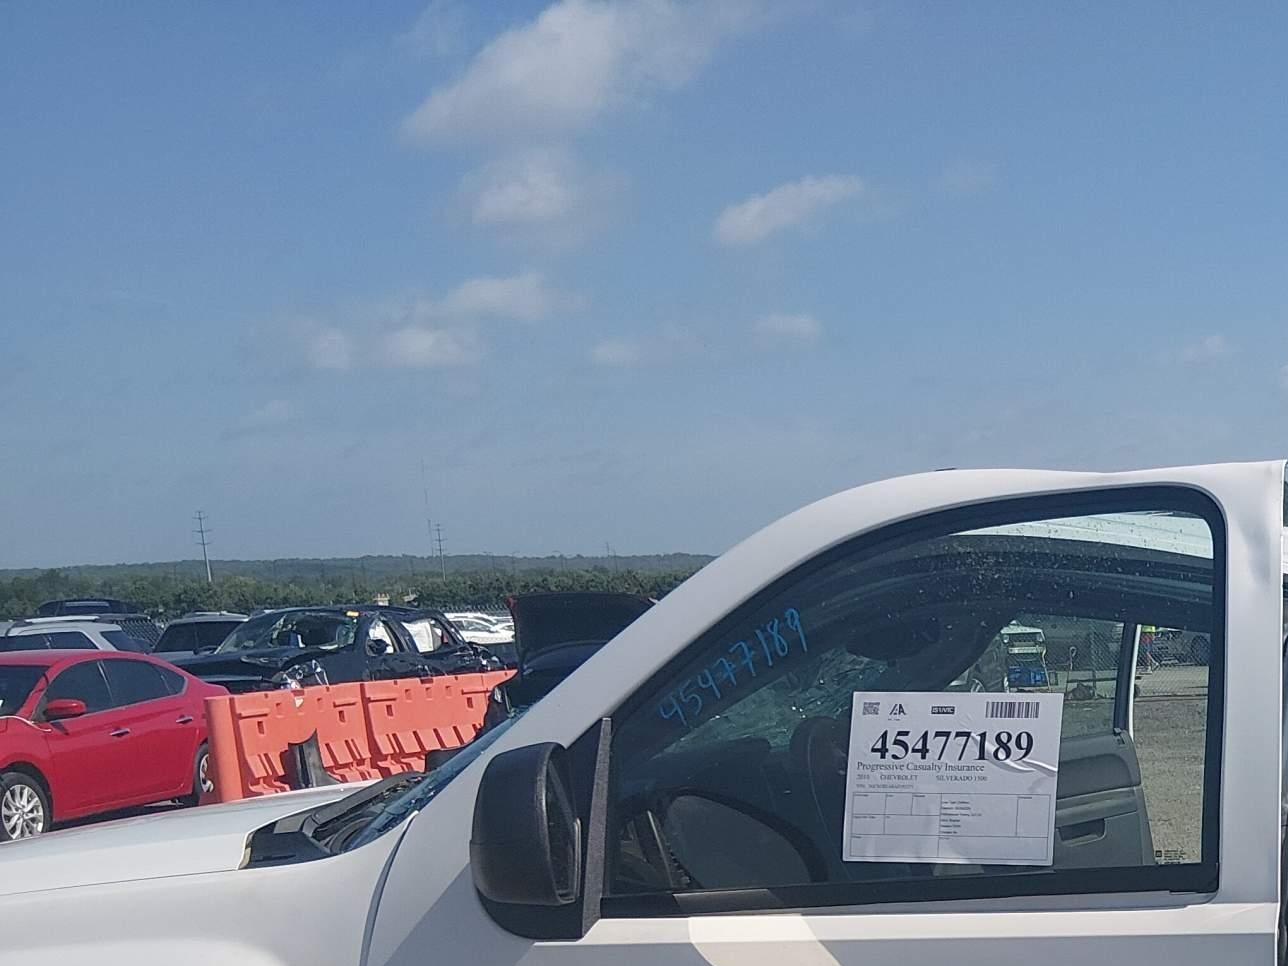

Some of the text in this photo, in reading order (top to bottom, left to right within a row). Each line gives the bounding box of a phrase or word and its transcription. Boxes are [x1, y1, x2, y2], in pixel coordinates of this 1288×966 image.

[659, 608, 807, 726] 45477189
[870, 729, 1034, 762] 45477189
[856, 761, 985, 773] Progressive Casualty Insurance
[935, 774, 972, 782] SILVERADO
